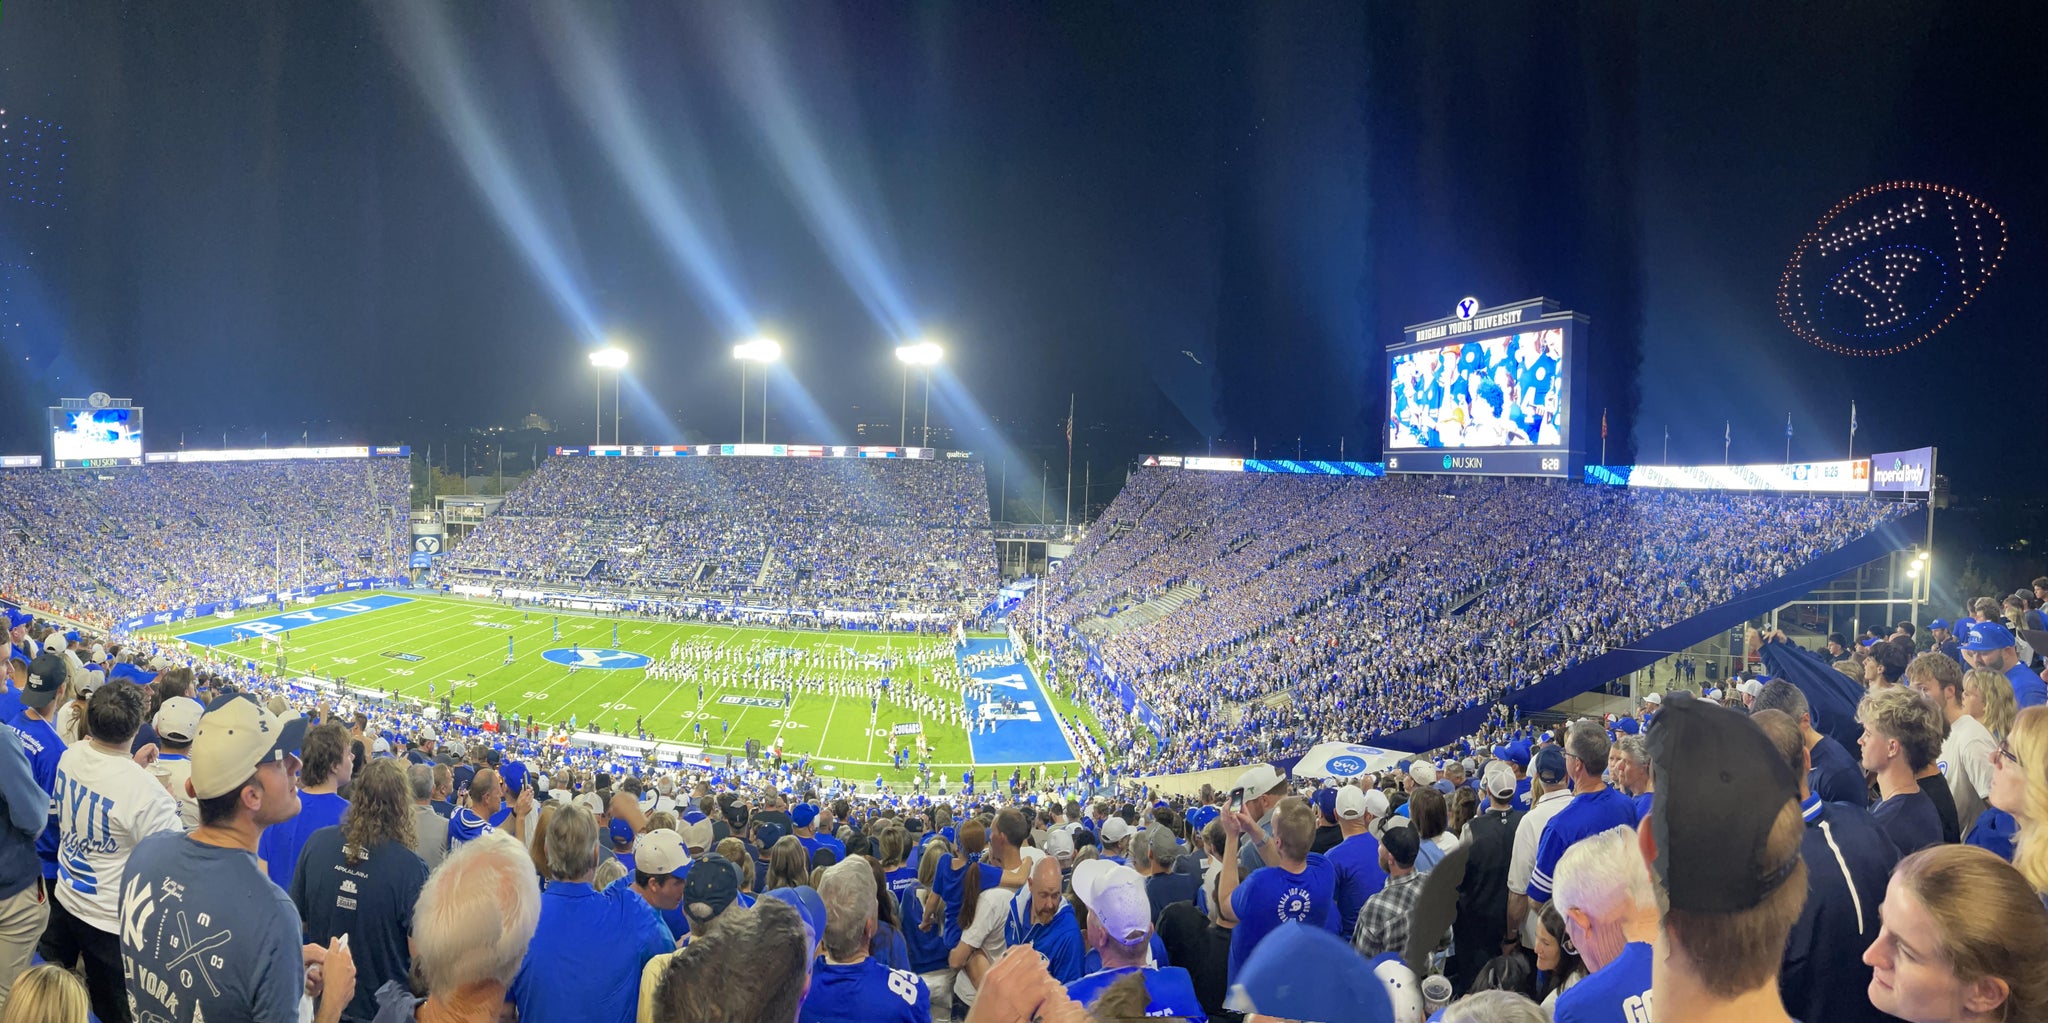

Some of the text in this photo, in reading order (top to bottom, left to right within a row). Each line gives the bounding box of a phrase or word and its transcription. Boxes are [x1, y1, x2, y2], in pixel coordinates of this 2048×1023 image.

[1459, 299, 1475, 318] Y
[1415, 310, 1522, 342] BRIGHAM YOUNG UNIVERSITY
[946, 450, 969, 459] qualtrics
[1452, 457, 1483, 469] NU SKIN
[1824, 466, 1839, 478] 6:25
[1874, 463, 1904, 487] Imperial
[232, 603, 372, 634] BYU
[522, 691, 549, 700] 50
[599, 702, 627, 711] 40
[680, 710, 711, 720] 30
[769, 719, 798, 729] 20
[894, 723, 920, 736] COUGARS
[865, 728, 888, 737] 10
[169, 934, 224, 970] 19 03
[137, 963, 179, 1017] YORK
